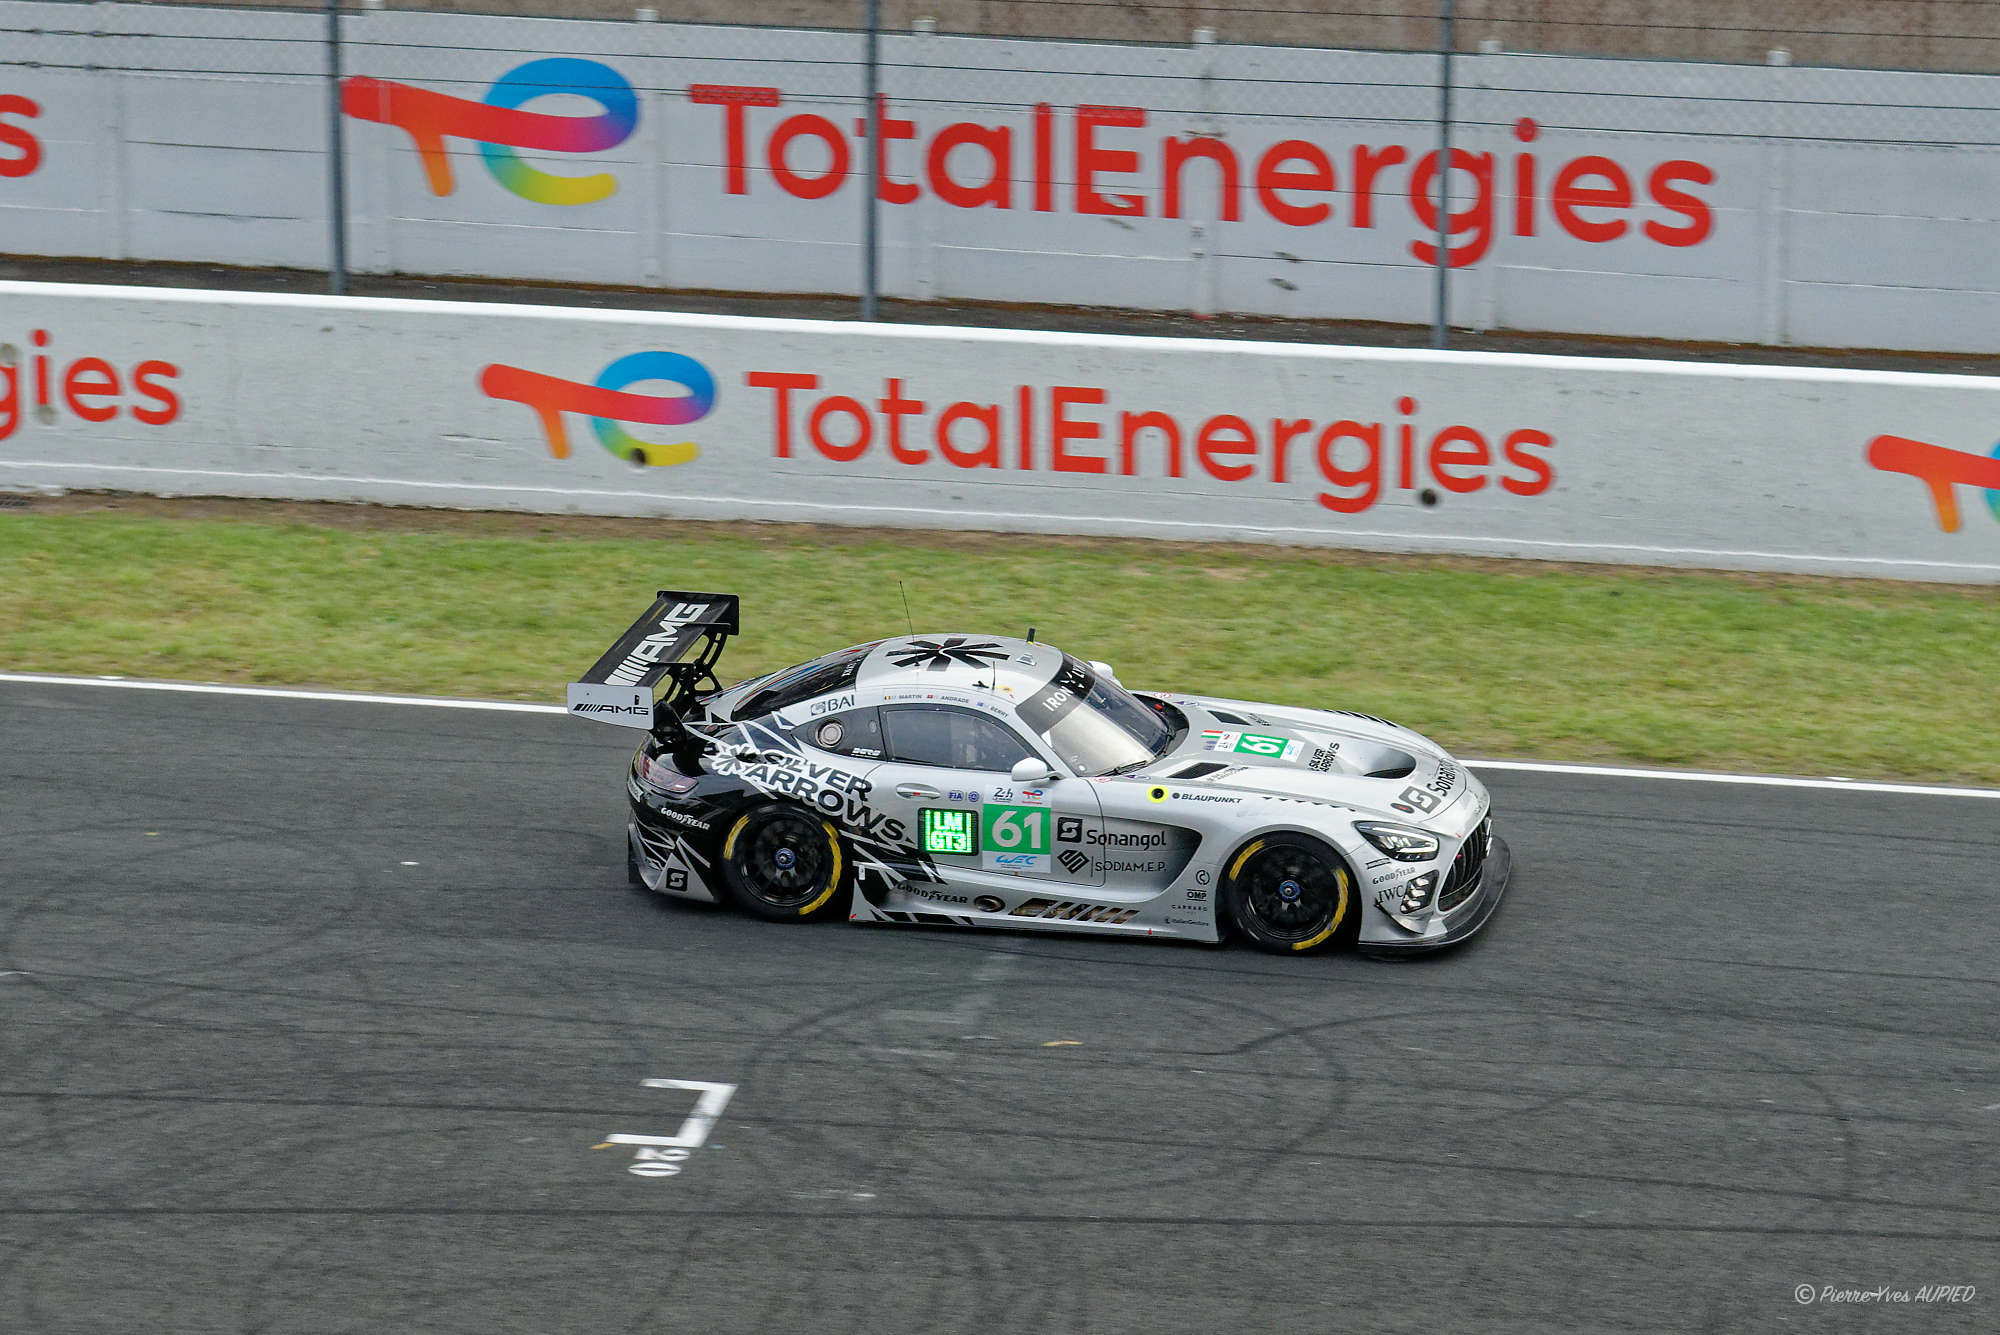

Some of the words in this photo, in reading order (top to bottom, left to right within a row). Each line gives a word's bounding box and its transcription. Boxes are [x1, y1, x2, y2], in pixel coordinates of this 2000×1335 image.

[688, 84, 1715, 269] TotalEnergies
[746, 371, 1556, 513] TotalEnergies
[597, 704, 649, 715] AMG
[827, 694, 855, 711] BAI
[1042, 685, 1074, 713] IRON
[1241, 735, 1284, 754] 61
[744, 764, 906, 841] ARROWS
[1181, 793, 1243, 804] BLAUPUNKT
[660, 807, 711, 831] GOODYEAR
[933, 811, 963, 830] LM
[991, 809, 1042, 850] 61
[1086, 829, 1166, 851] Sonangol
[1372, 866, 1416, 885] GOODYEAR
[897, 881, 968, 904] GOODYEAR
[1378, 885, 1404, 903] IWC
